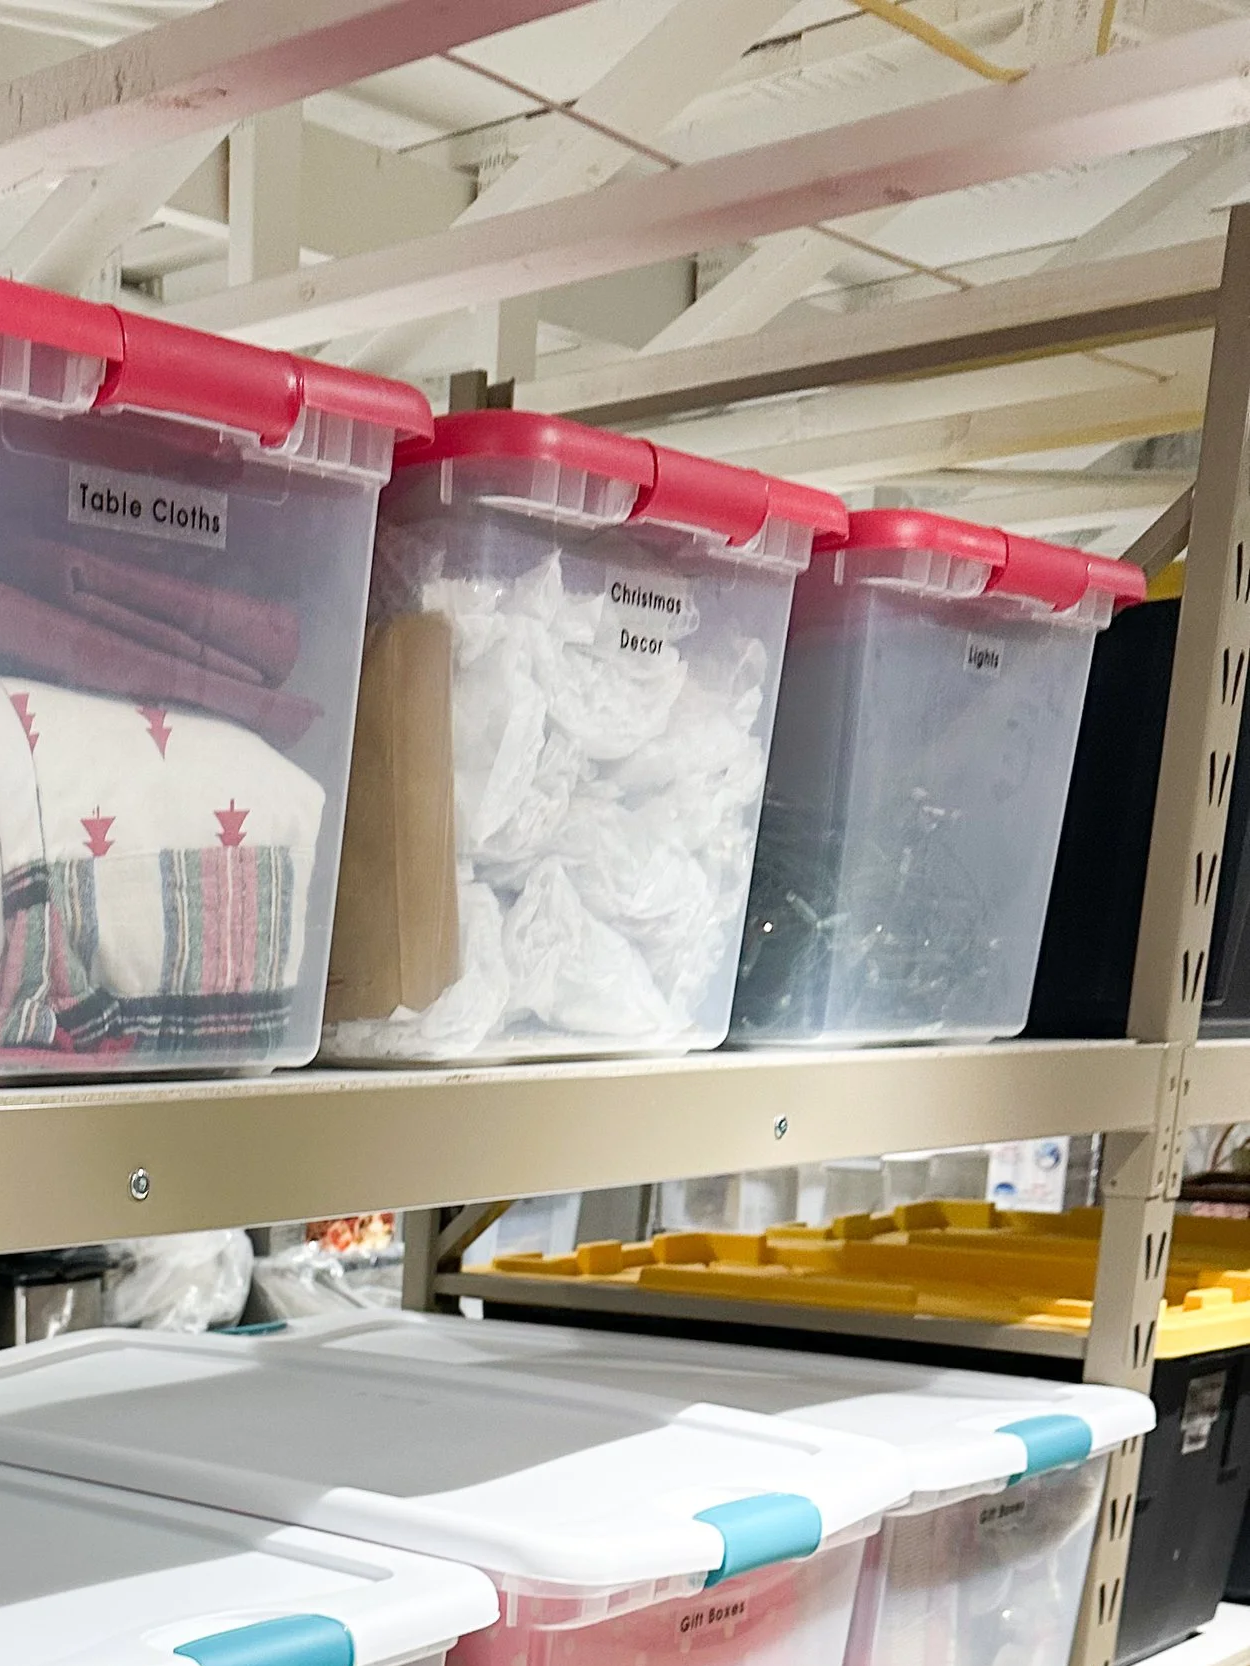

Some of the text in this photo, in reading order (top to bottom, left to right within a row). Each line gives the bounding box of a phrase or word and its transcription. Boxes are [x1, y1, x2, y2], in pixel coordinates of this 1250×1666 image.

[79, 482, 221, 534] Table Cloths
[610, 581, 682, 615] Christmas
[619, 628, 665, 655] Decor
[967, 643, 1000, 670] Lights
[680, 1601, 746, 1633] Gift Boxes
